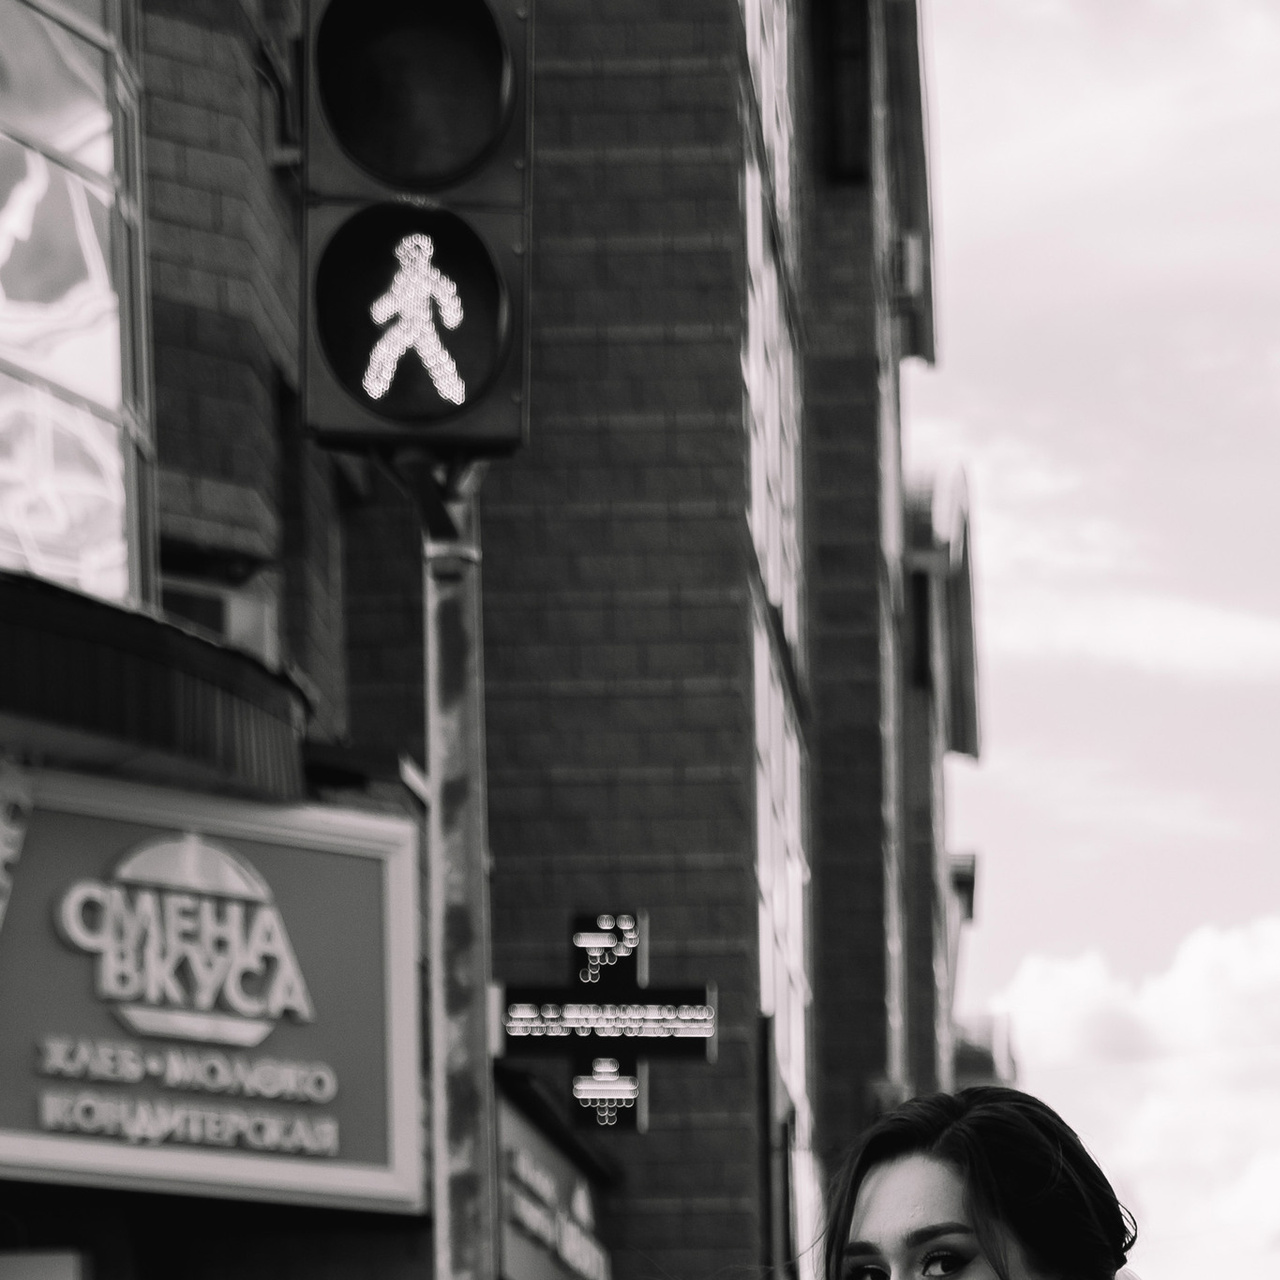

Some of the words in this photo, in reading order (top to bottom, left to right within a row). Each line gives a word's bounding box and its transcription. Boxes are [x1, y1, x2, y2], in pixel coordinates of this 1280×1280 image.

[60, 878, 290, 955] СМЕНА
[97, 938, 316, 1022] ВКУСА
[42, 1036, 145, 1083] ХЛЕБ
[162, 1047, 338, 1103] МОЛОКО
